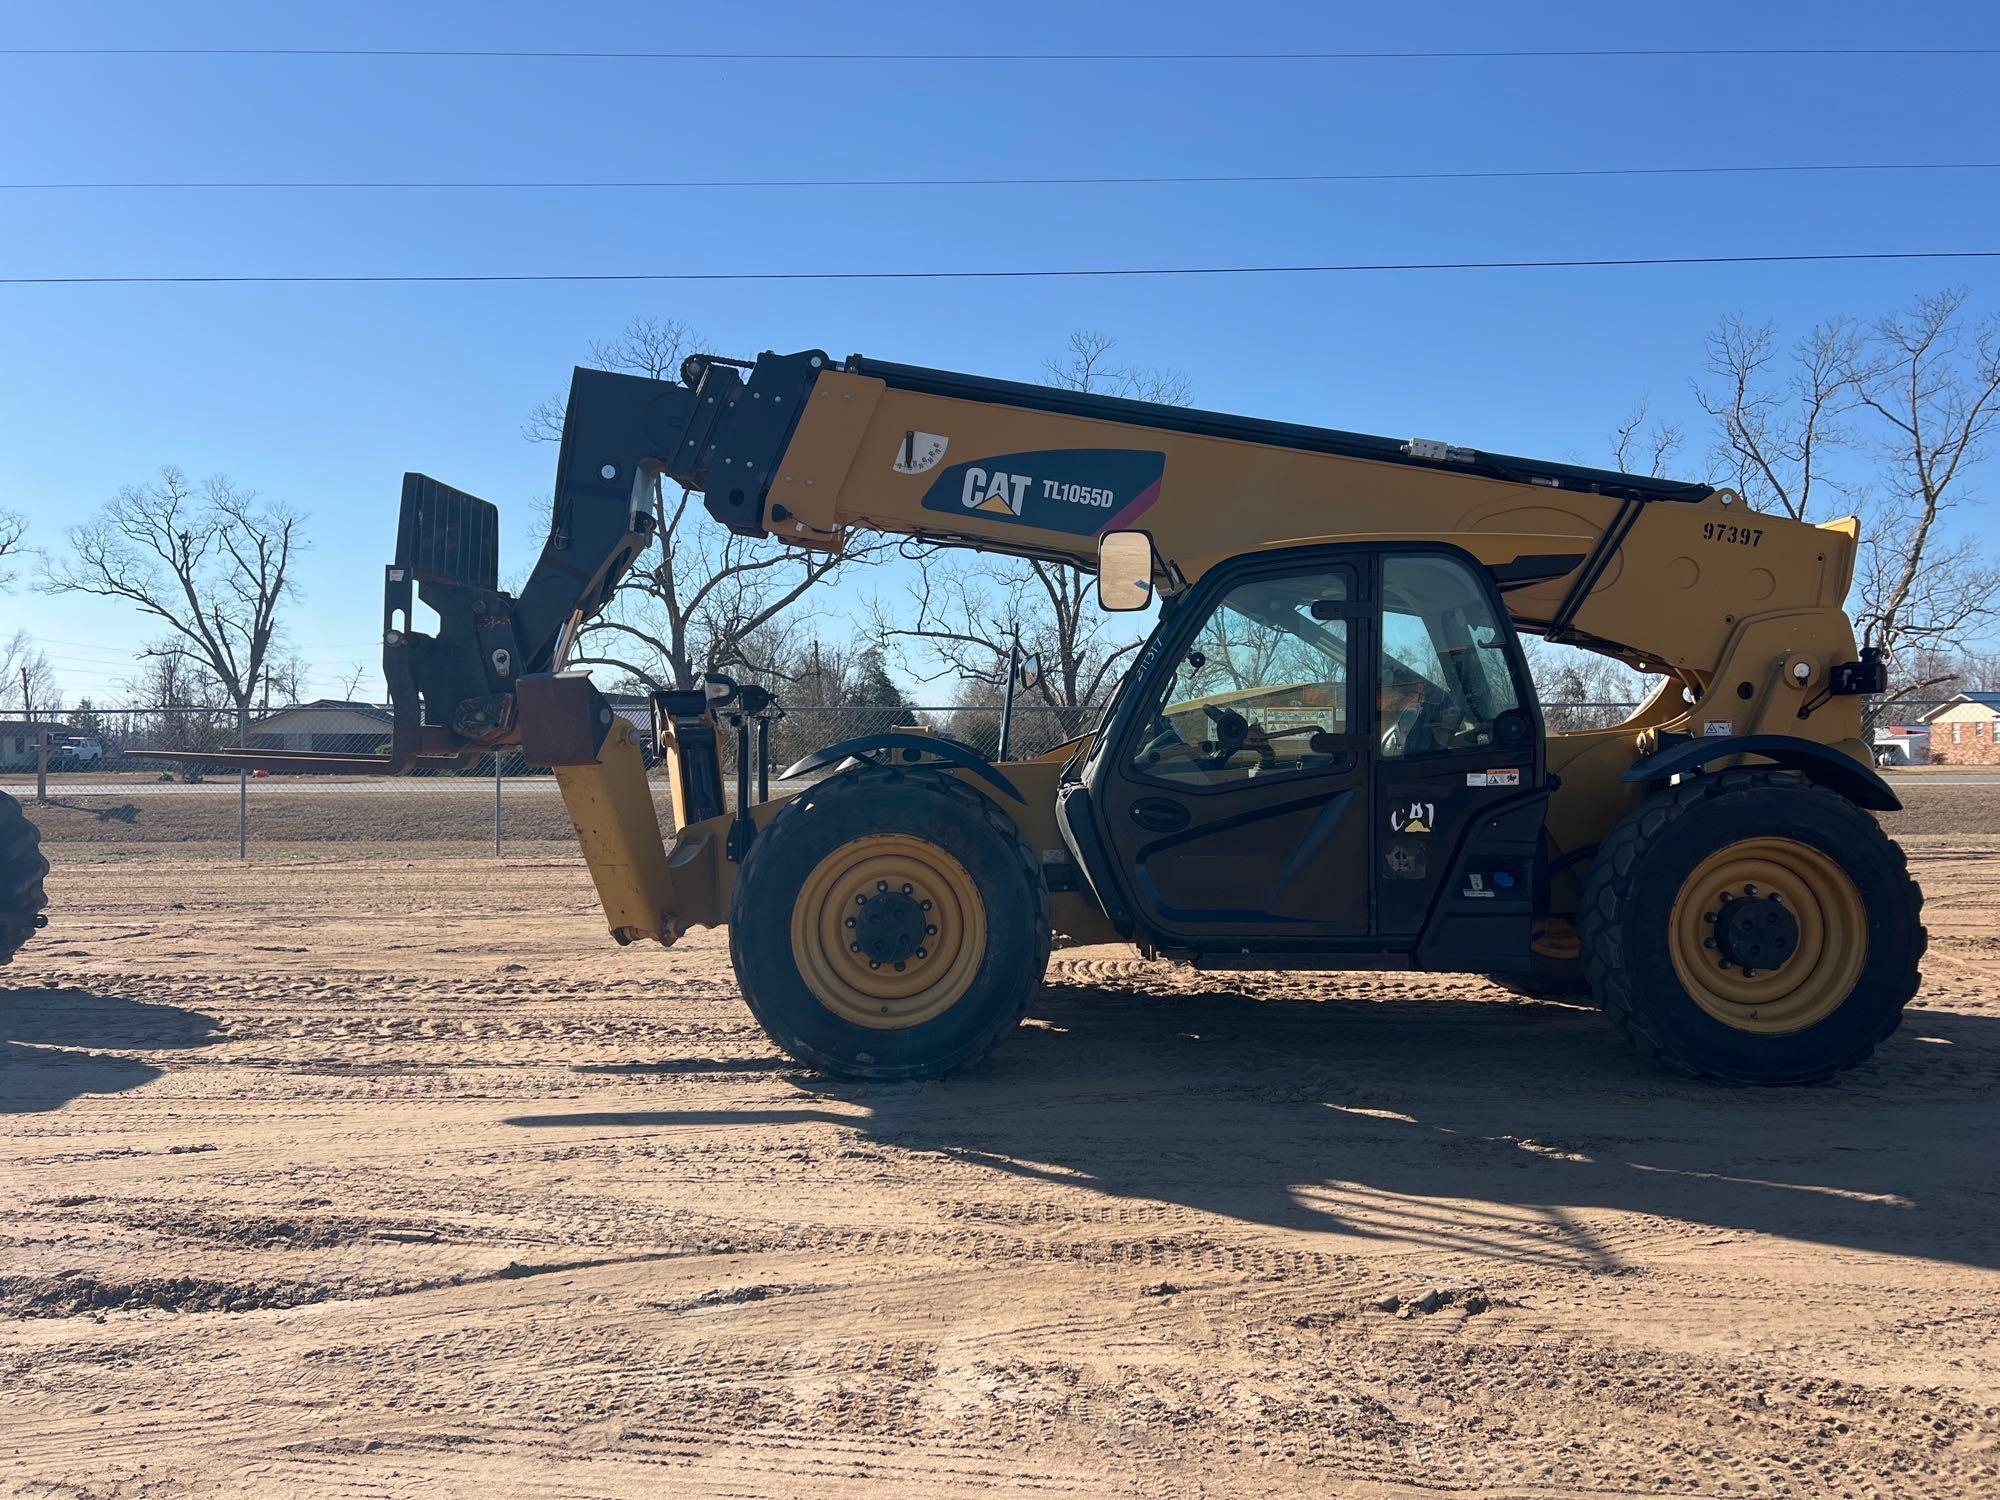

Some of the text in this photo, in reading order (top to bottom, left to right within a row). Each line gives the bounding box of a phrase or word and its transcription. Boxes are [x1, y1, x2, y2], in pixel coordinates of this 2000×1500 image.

[961, 467, 1114, 516] CAT TL1055D
[1703, 522, 1764, 547] 97397
